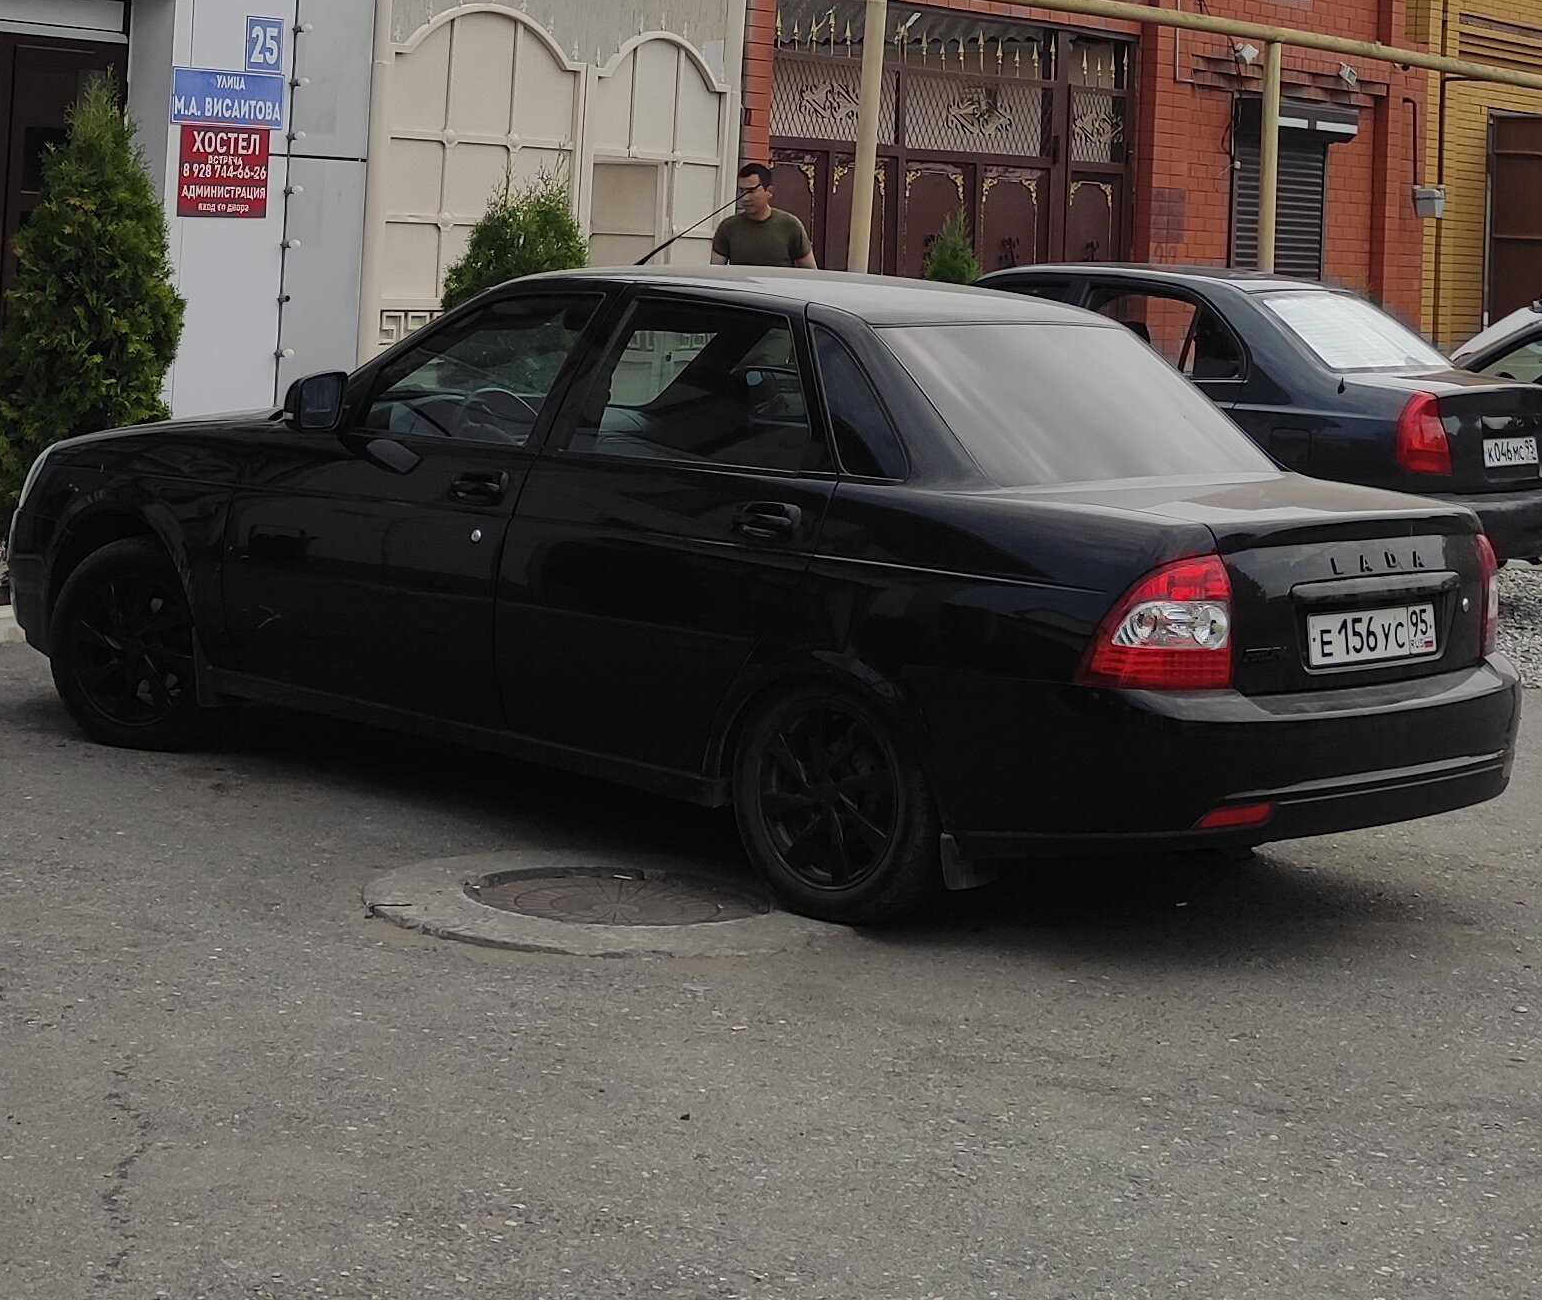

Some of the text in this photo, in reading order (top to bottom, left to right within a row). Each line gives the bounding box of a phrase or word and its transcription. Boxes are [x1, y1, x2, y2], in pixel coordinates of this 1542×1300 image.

[250, 25, 279, 65] 25
[216, 74, 246, 91] УЛИЦА
[205, 97, 281, 121] ВИСАИТОВА
[192, 130, 260, 155] ХОСТЕЛ
[183, 163, 267, 180] 8 928 744-66-26
[208, 155, 243, 166] ВСТРЕЧА
[181, 184, 266, 200] АДМИНИСТРАЦИЯ
[1330, 550, 1425, 576] LADA
[1410, 608, 1428, 638] 95
